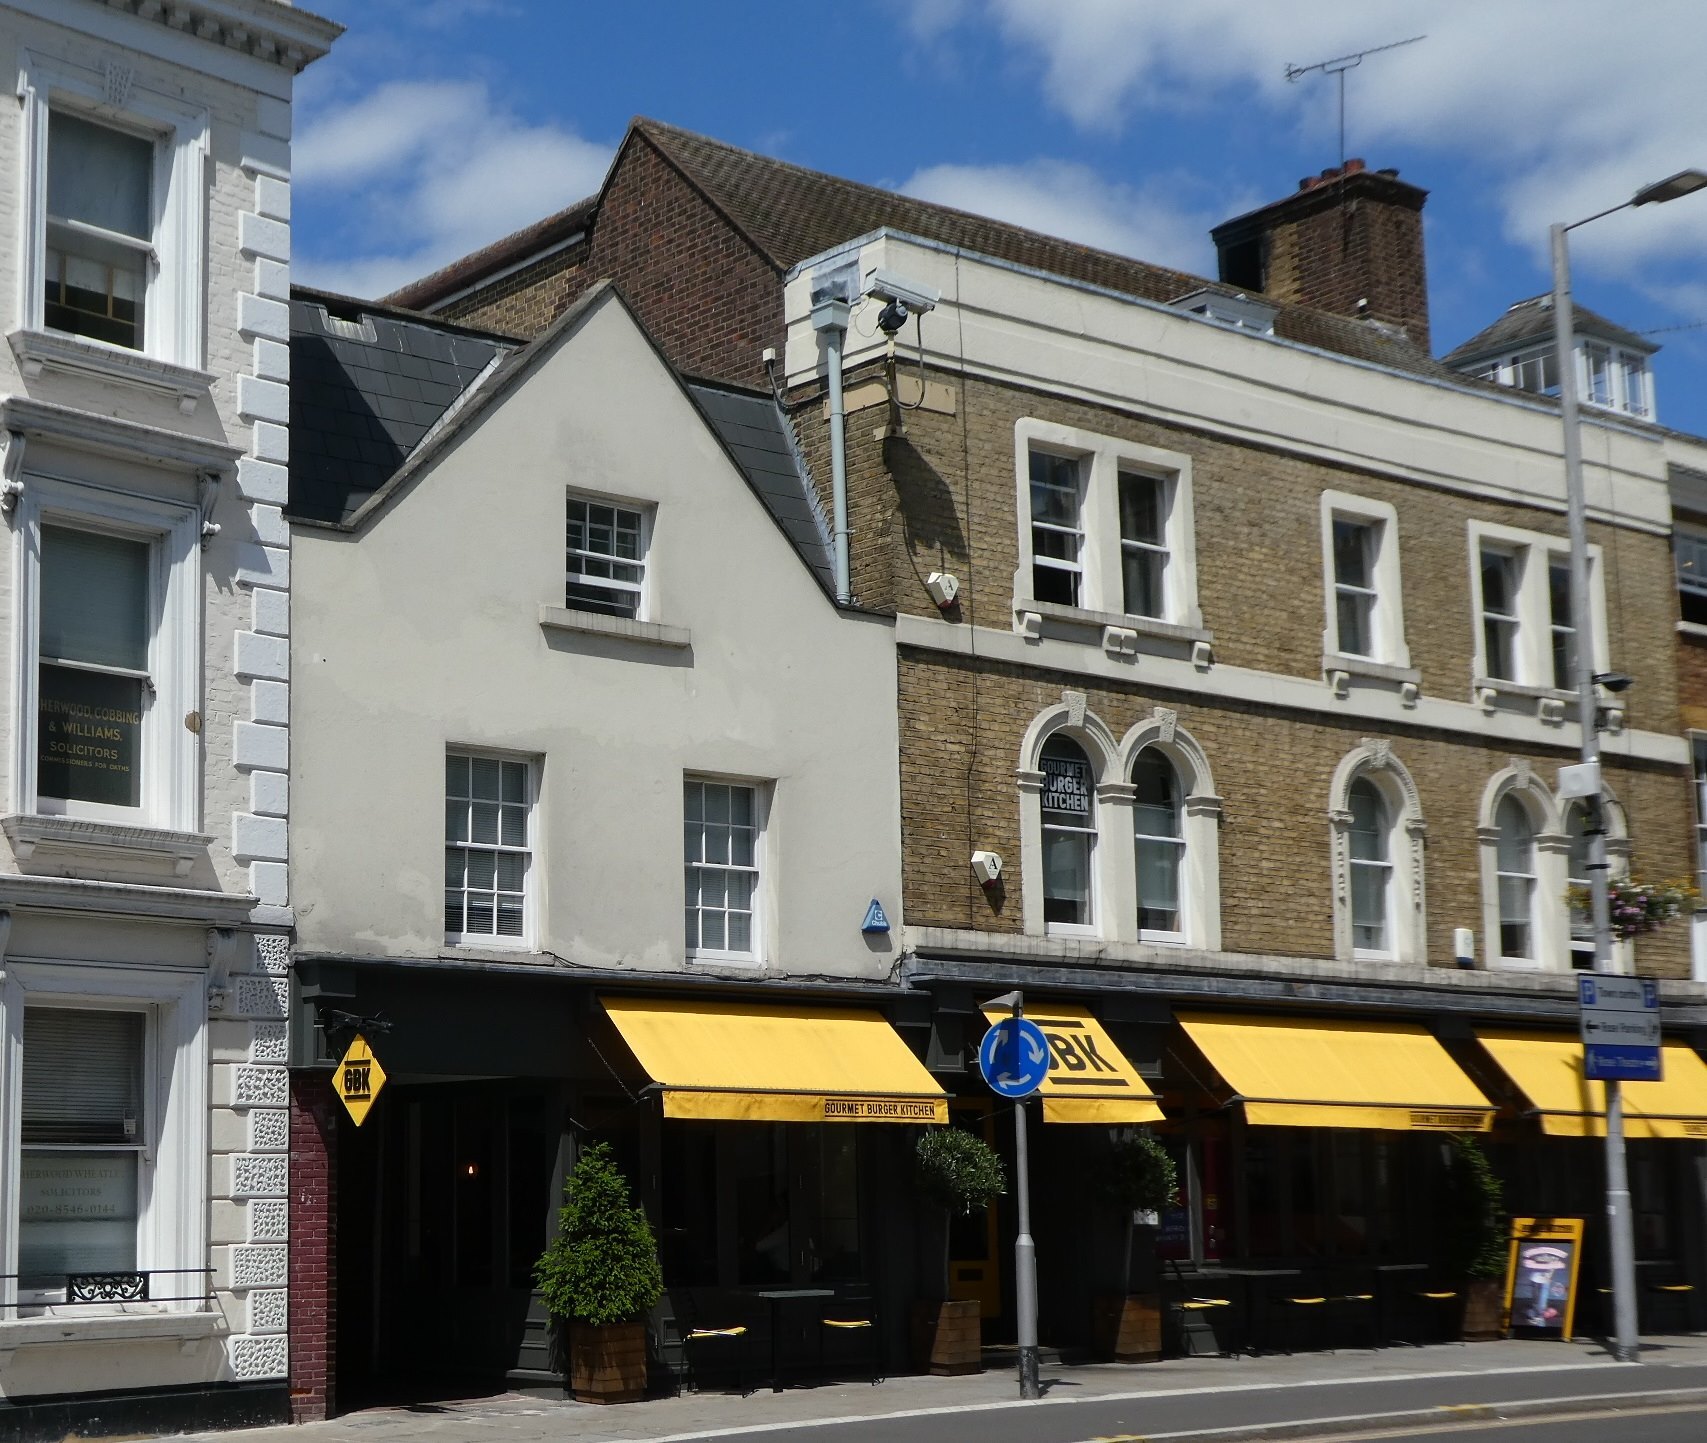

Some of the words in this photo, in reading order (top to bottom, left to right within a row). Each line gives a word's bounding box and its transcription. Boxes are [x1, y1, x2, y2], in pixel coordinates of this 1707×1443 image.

[94, 707, 140, 725] COBBING
[48, 720, 57, 733] &
[50, 741, 118, 759] SOLICITORS
[1041, 760, 1087, 780] GOURMET
[1042, 775, 1088, 795] BURGER
[1041, 792, 1089, 811] KITCHEN
[988, 857, 998, 870] A
[344, 1066, 371, 1092] GBK
[825, 1102, 865, 1115] GOURMET
[867, 1103, 898, 1115] BURGER
[900, 1104, 935, 1117] KITCHEN
[40, 1187, 102, 1197] SOLICITORS
